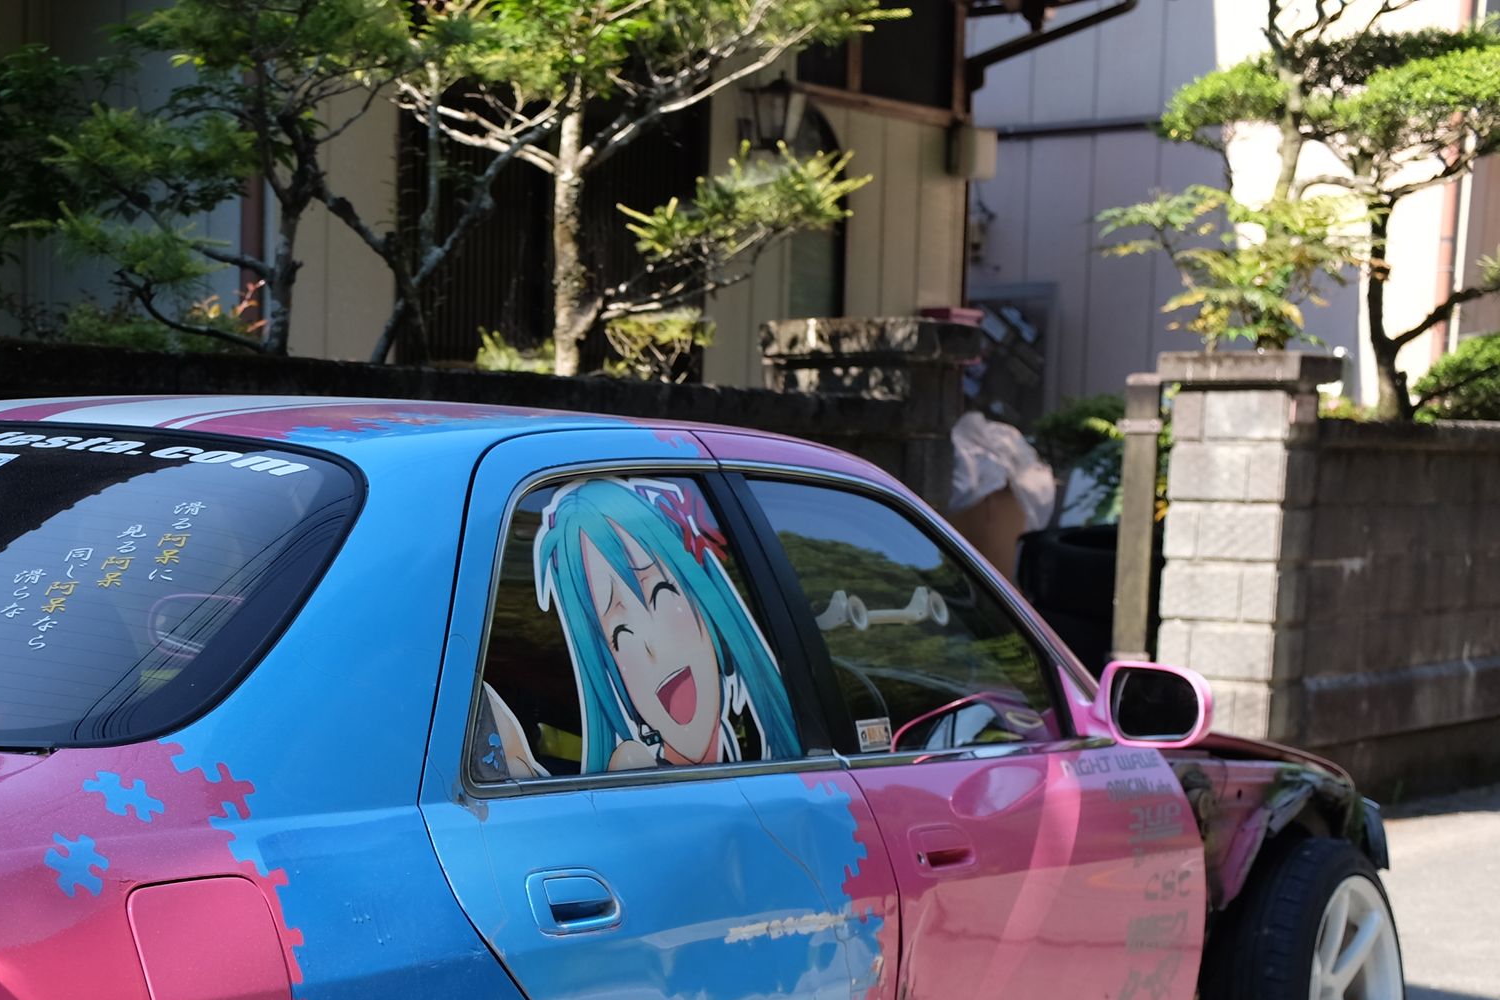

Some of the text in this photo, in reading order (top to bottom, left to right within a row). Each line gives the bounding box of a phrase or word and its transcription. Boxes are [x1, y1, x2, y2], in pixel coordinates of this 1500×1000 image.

[97, 524, 147, 588] 見る阿呆
[148, 501, 207, 581] 滑る阿呆に
[0, 568, 47, 618] 滑らな
[28, 547, 94, 650] 同じ阿呆なら
